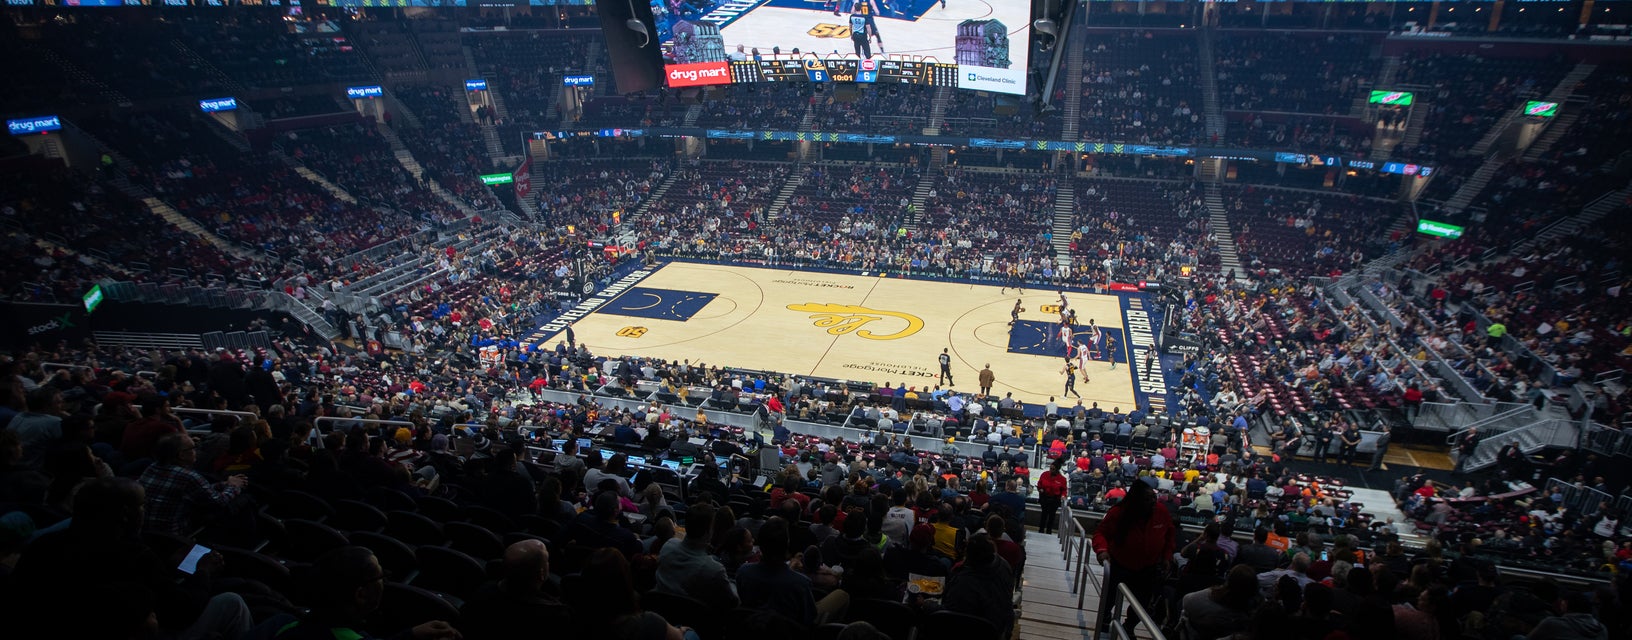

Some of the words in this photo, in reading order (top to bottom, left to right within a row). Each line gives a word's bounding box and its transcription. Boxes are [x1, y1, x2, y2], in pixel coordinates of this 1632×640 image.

[671, 68, 697, 80] drug
[699, 67, 727, 78] mart
[815, 71, 822, 81] 6
[863, 71, 870, 81] 6
[977, 75, 1001, 83] Cleveland
[564, 77, 578, 86] drug
[578, 76, 593, 84] mart
[348, 86, 365, 97] drug
[365, 85, 383, 95] mart
[219, 97, 236, 108] mart
[9, 119, 35, 133] drug
[35, 116, 60, 129] mart
[539, 297, 606, 332] CLEVELAND
[1126, 309, 1156, 347] CLEVELAND
[842, 363, 898, 374] Mortgage
[869, 361, 928, 371] FIELDHOUSE
